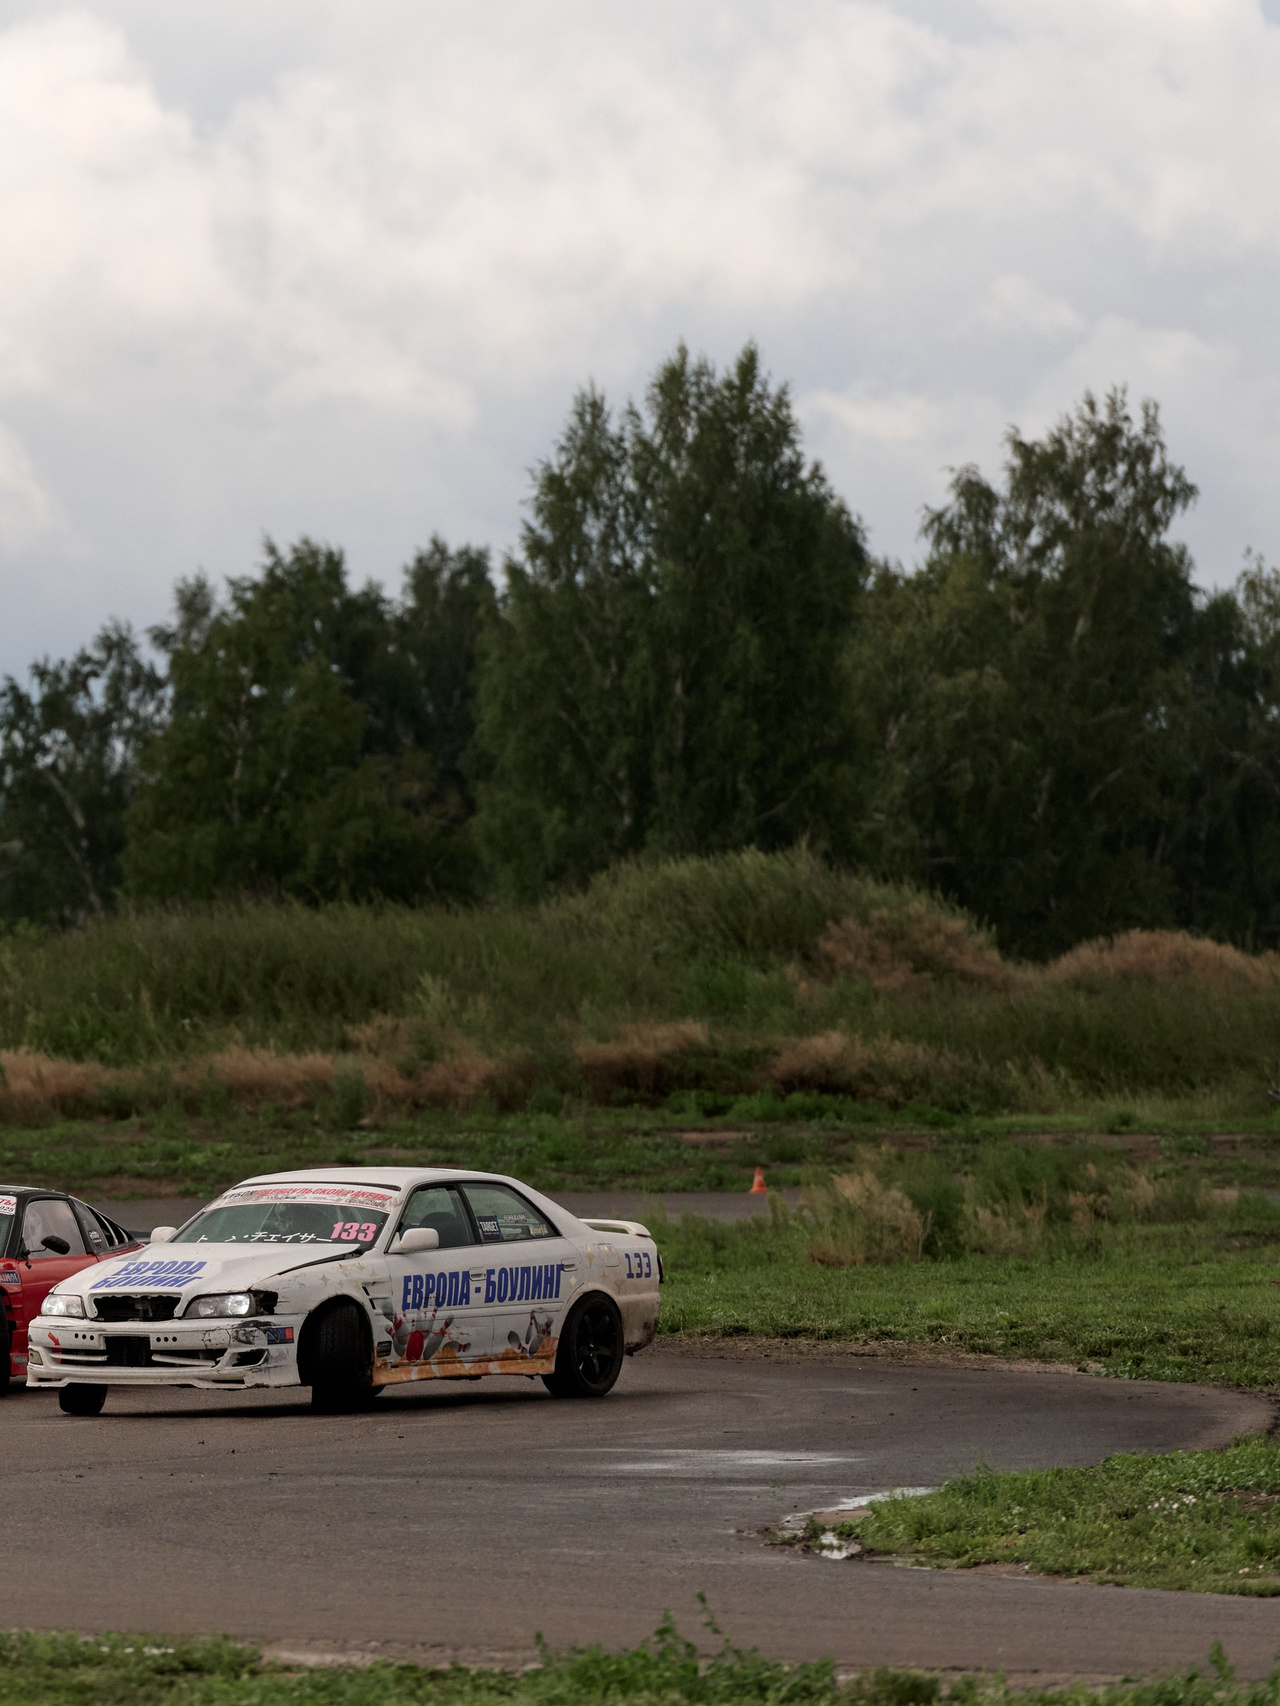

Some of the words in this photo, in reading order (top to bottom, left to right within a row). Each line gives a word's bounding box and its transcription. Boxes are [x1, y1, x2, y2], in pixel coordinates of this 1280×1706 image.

[343, 1189, 392, 1201] РАКЕТЫ
[330, 1222, 377, 1242] 133
[479, 1221, 499, 1232] TARGET
[111, 1260, 208, 1276] ЕВРОПА
[624, 1252, 652, 1279] 133
[89, 1275, 204, 1290] БОУЛИНГ
[401, 1271, 471, 1310] ЕВРОПА
[484, 1264, 564, 1303] БОУЛИНГ
